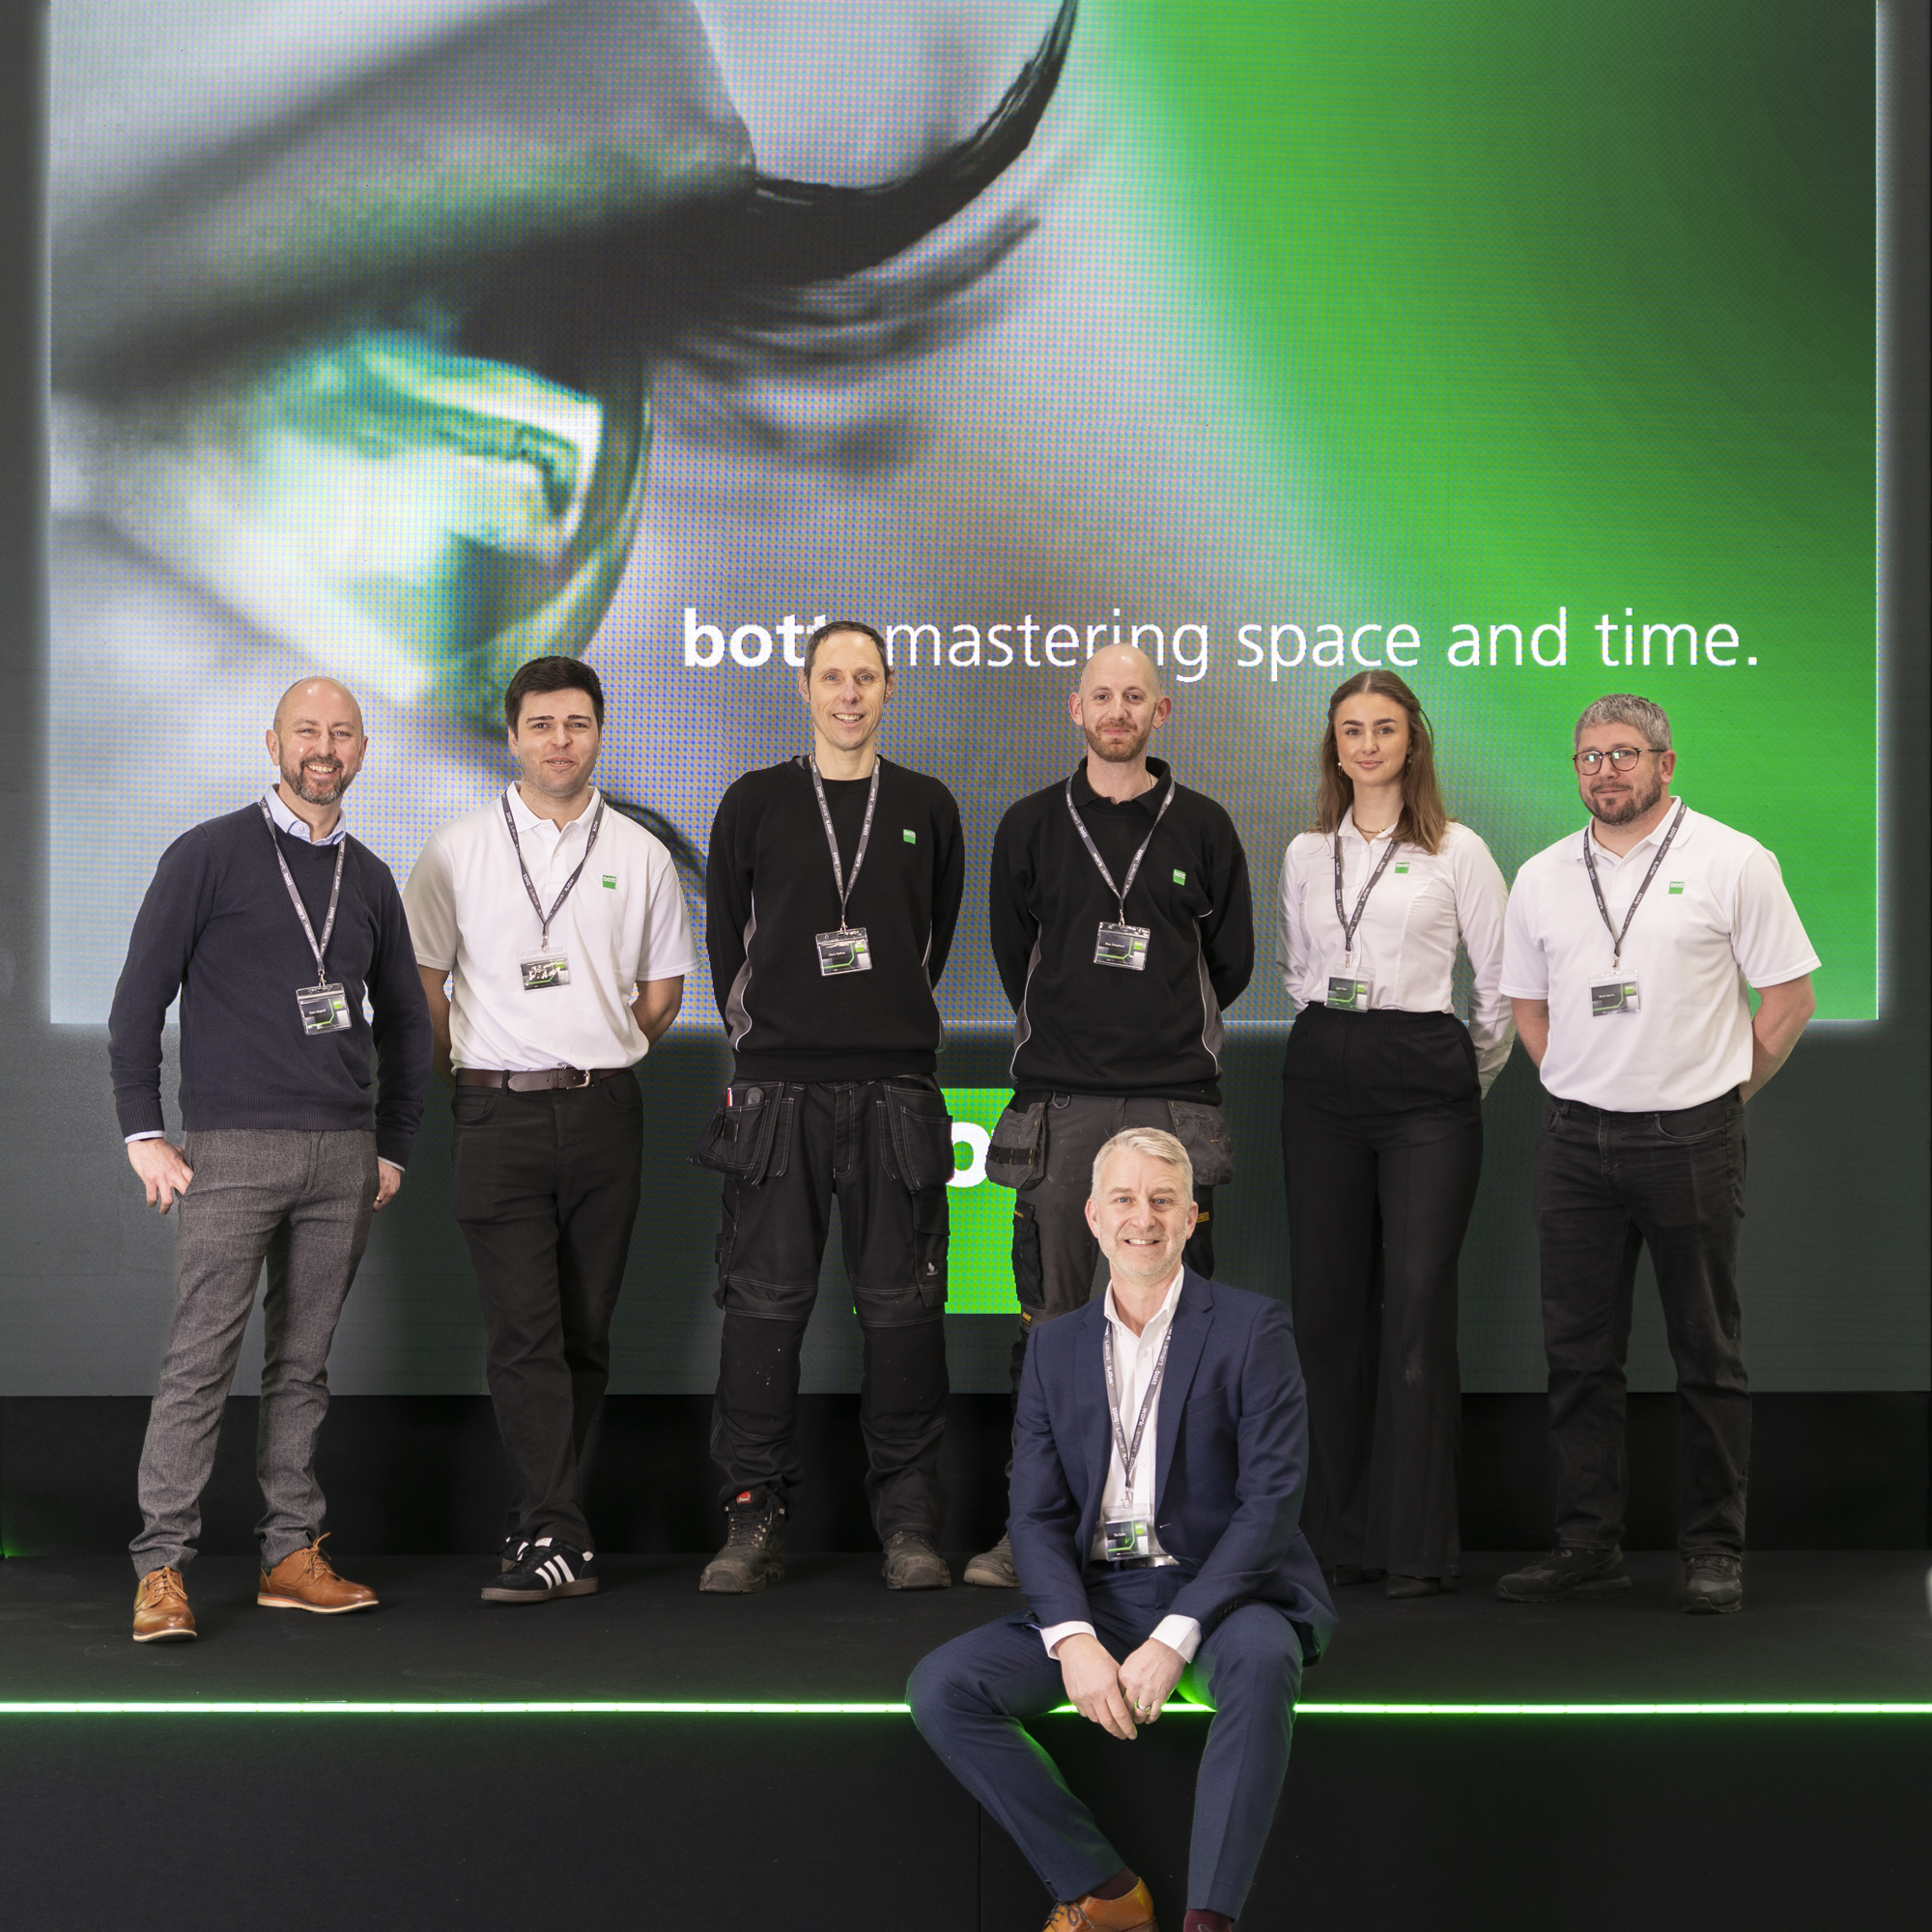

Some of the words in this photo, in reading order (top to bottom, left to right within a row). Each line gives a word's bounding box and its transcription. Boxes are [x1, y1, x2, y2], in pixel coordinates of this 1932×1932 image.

[886, 608, 1208, 683] mastering
[1236, 621, 1421, 682] space
[1447, 606, 1567, 668] and
[1594, 607, 1759, 668] time.
[904, 830, 916, 838] bott
[1174, 870, 1186, 879] bott
